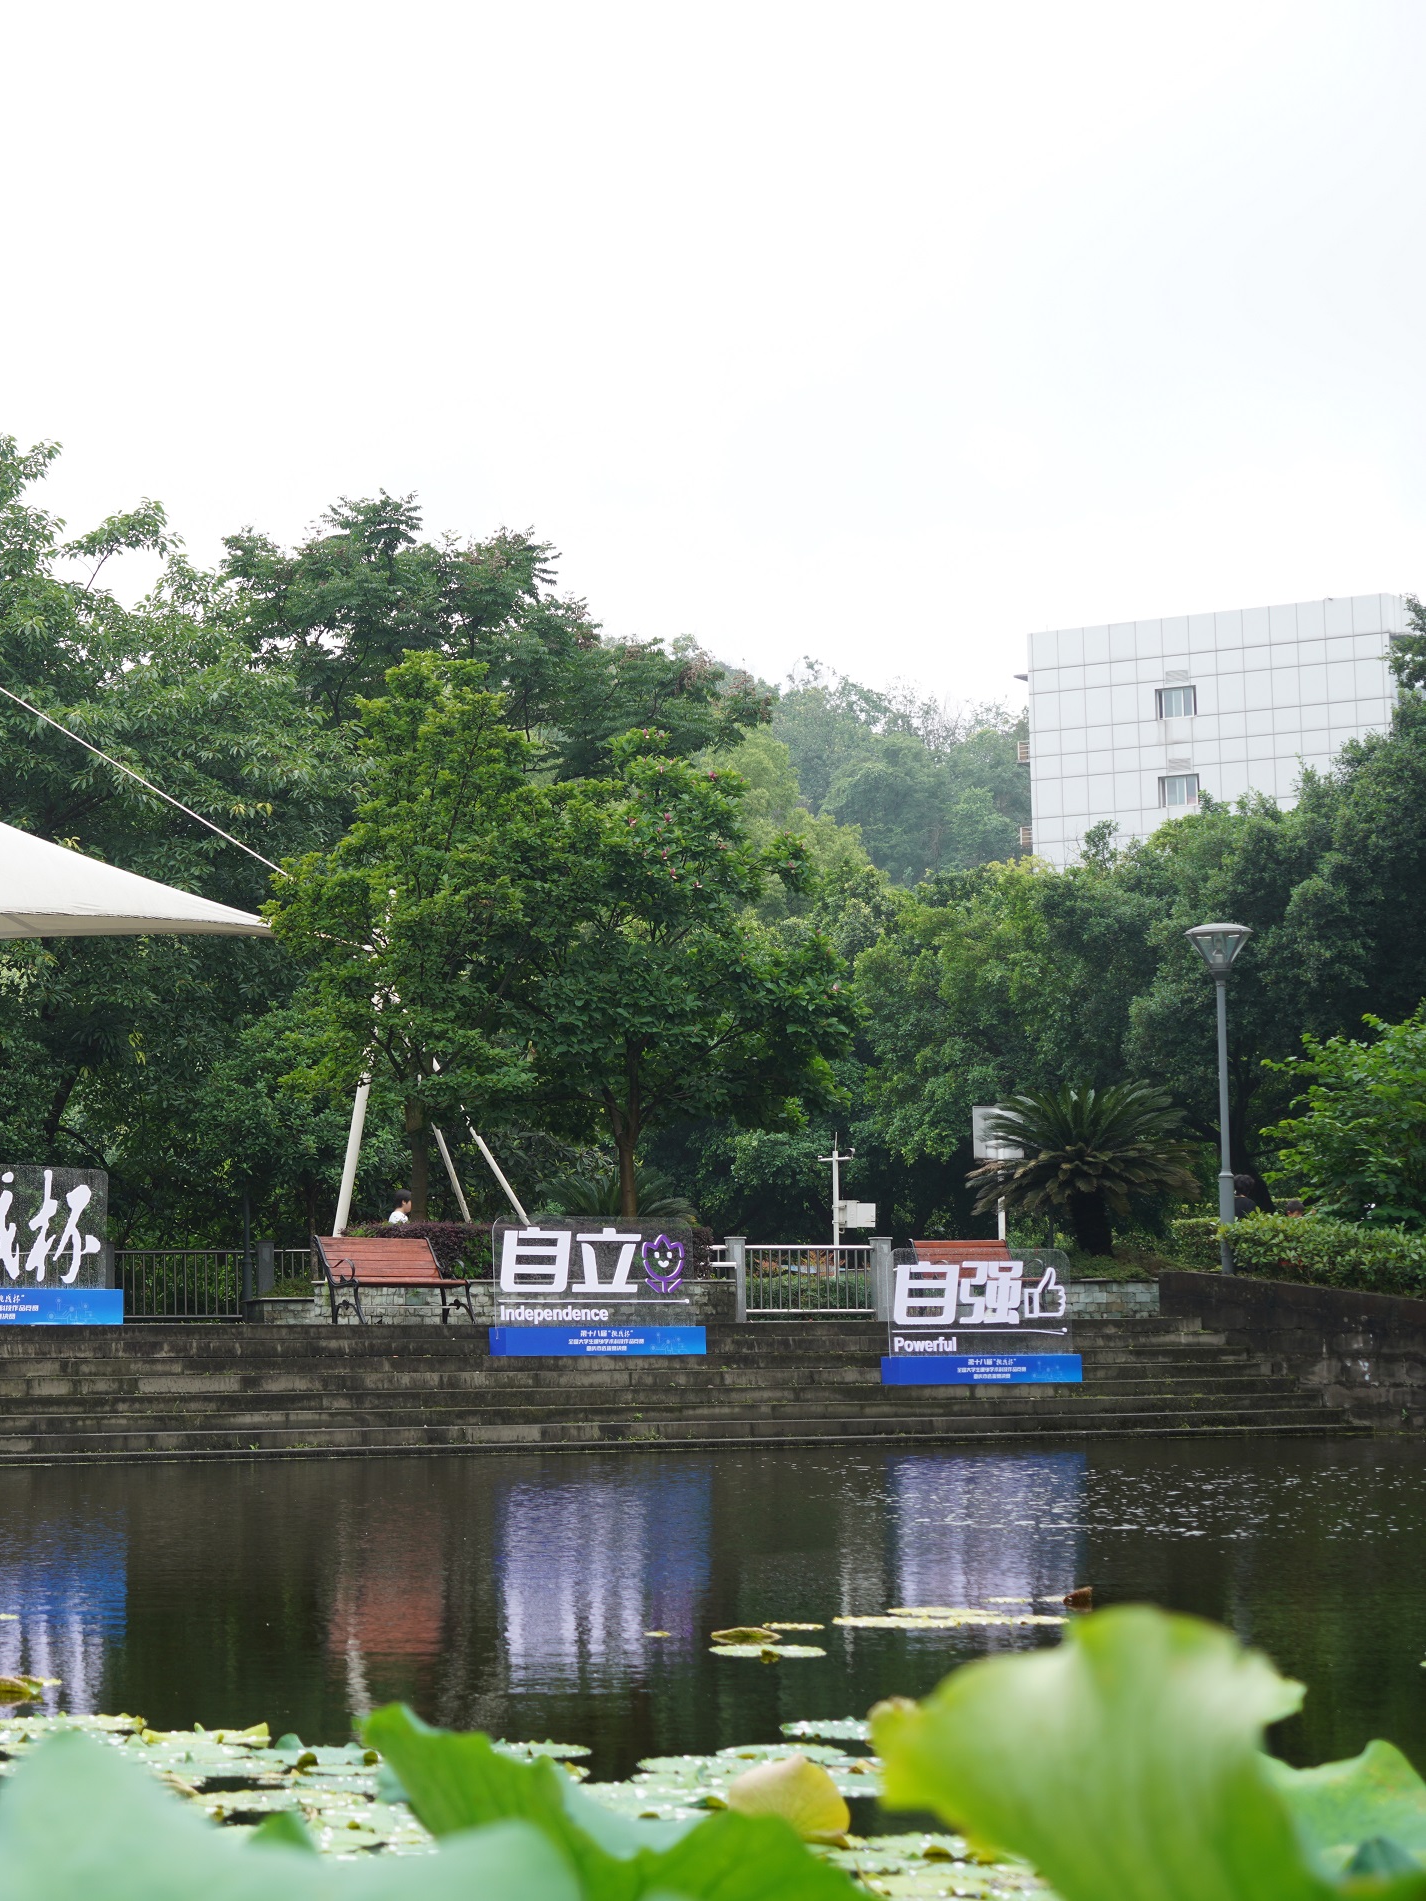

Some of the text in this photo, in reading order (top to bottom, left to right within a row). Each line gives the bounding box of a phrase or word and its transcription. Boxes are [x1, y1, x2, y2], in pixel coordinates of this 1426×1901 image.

[500, 1226, 642, 1293] 自立
[893, 1261, 1024, 1325] 自强
[500, 1305, 609, 1324] Independence
[893, 1337, 957, 1352] Powerful
